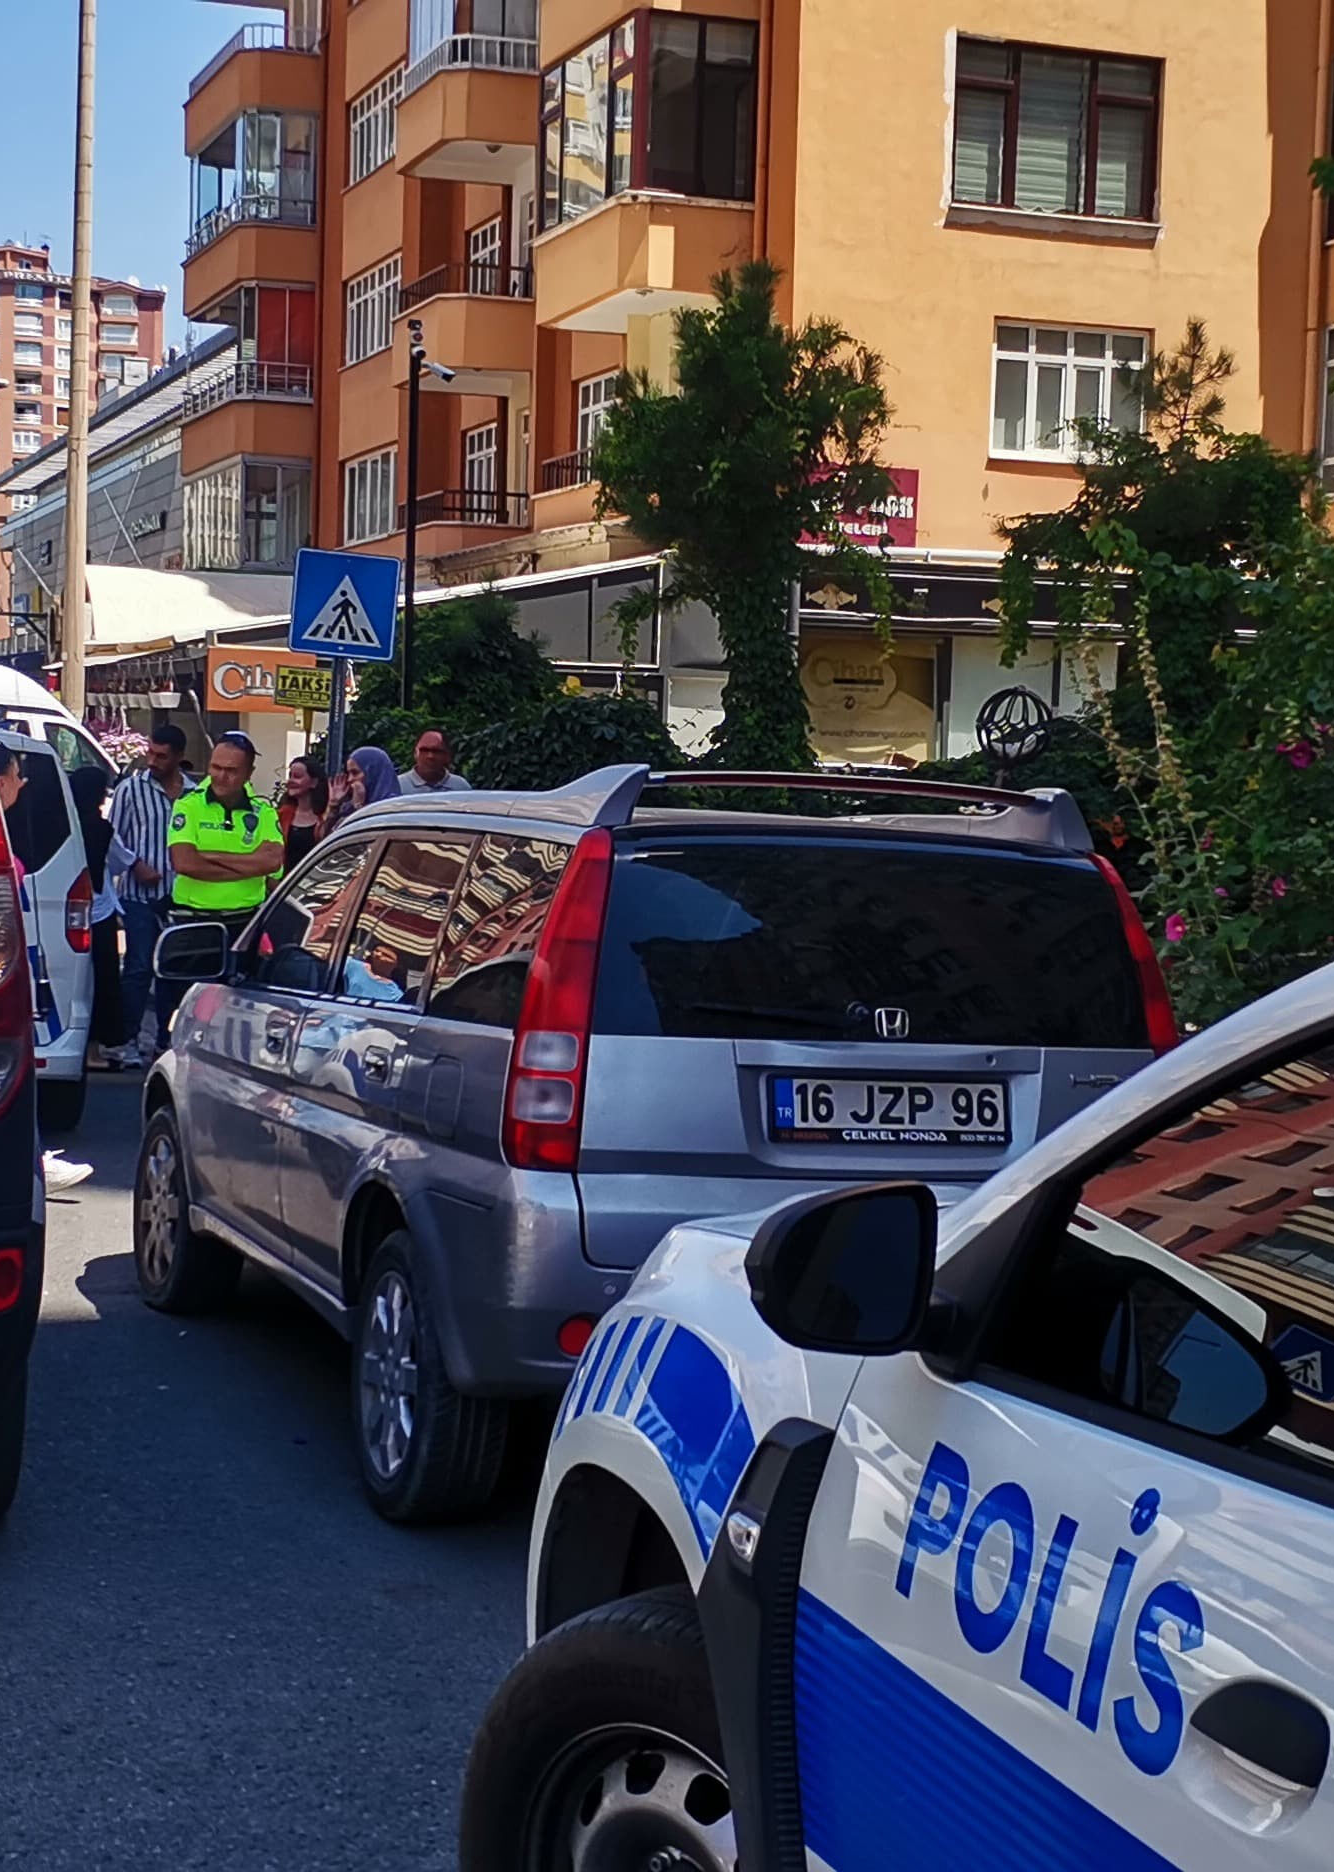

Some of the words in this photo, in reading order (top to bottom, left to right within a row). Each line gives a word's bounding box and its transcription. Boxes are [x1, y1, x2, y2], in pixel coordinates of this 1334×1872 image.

[777, 1107, 793, 1119] TR
[795, 1083, 834, 1125] 16
[849, 1085, 934, 1126] JZP
[951, 1087, 999, 1128] 96
[899, 1131, 948, 1142] HONDA
[896, 1440, 1206, 1777] POLİS
